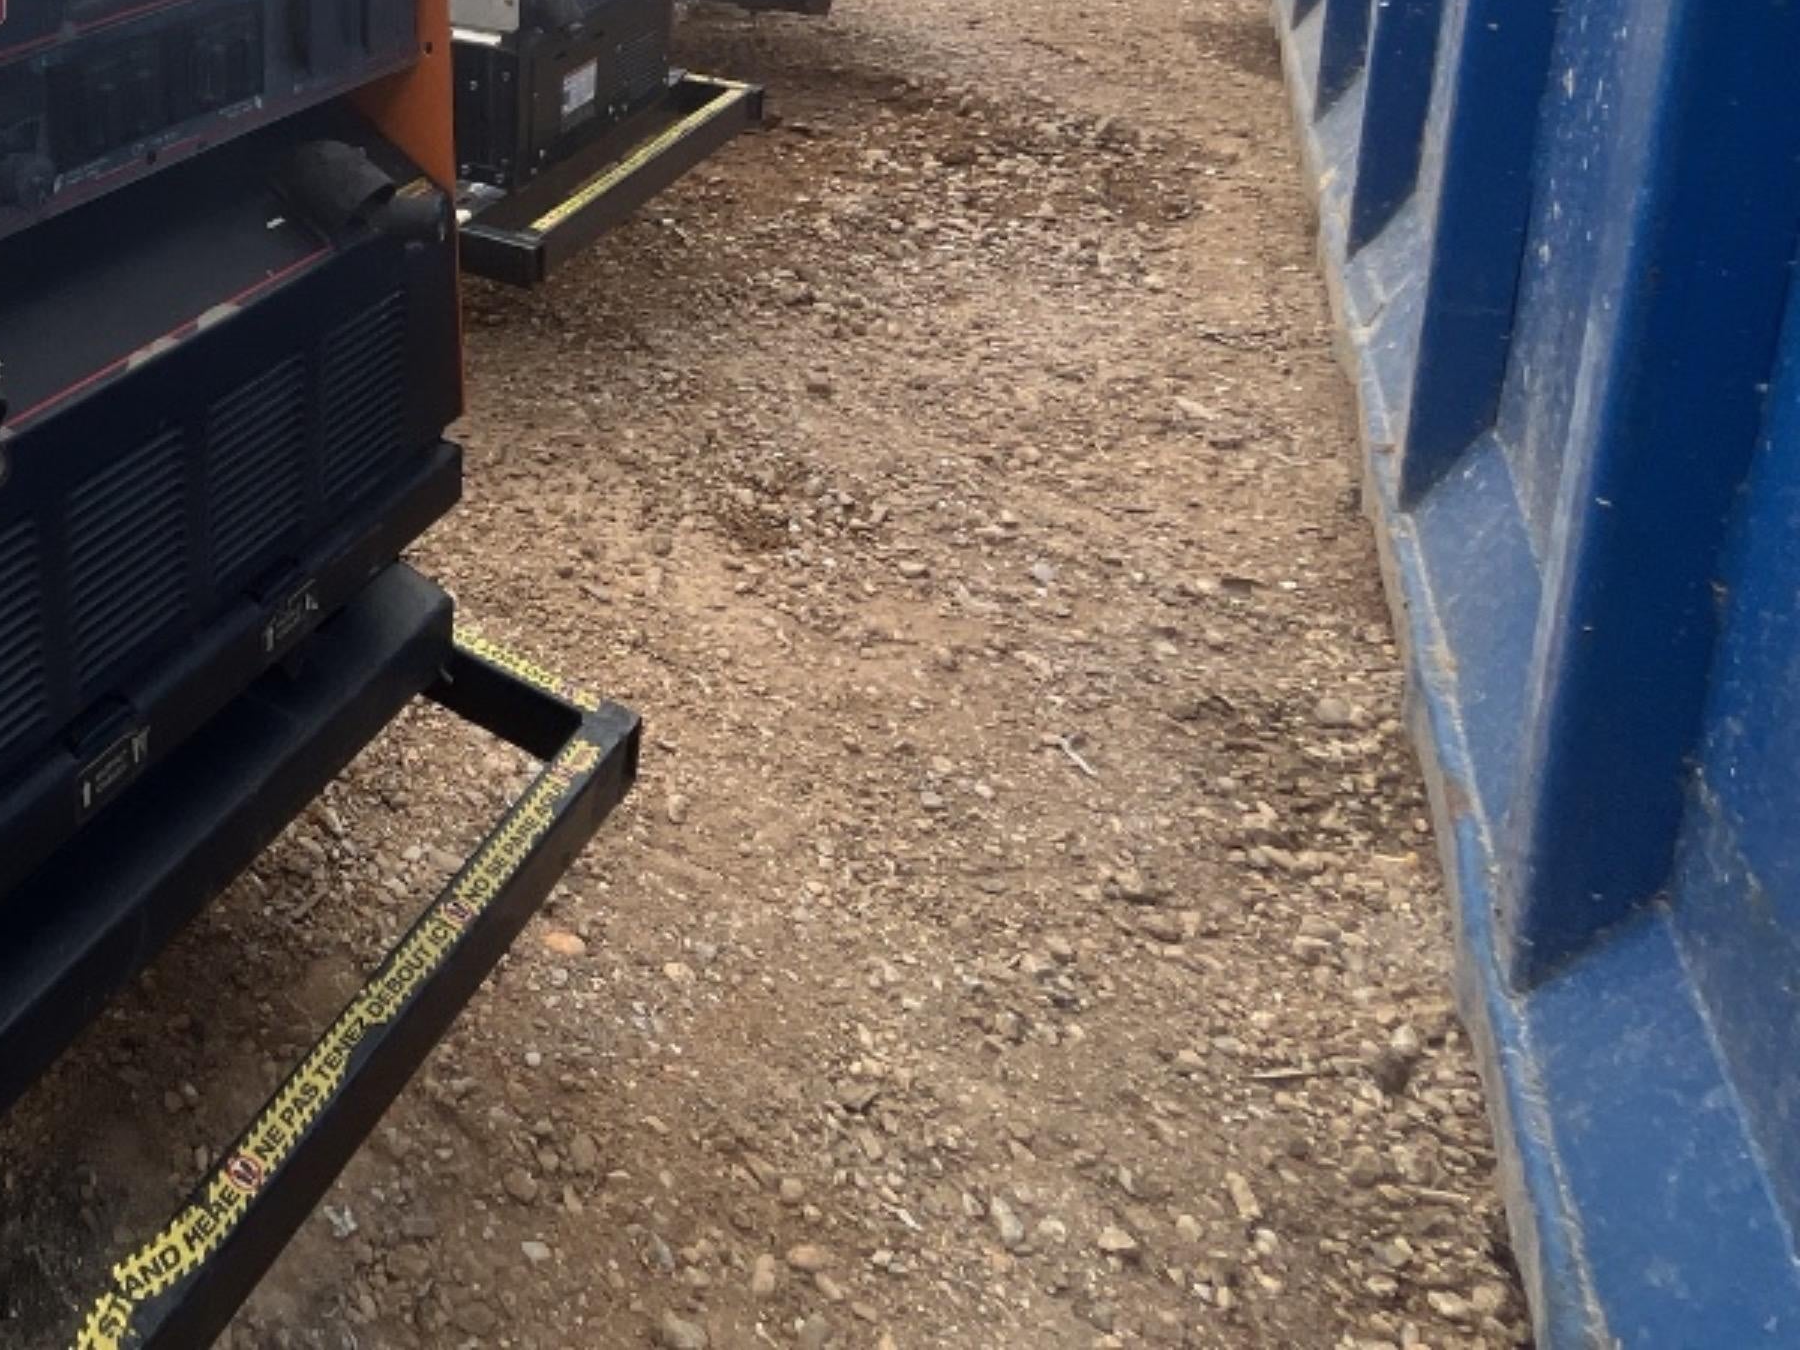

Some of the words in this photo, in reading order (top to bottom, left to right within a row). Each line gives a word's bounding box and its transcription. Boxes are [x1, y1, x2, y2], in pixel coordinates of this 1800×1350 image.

[182, 1184, 241, 1252] HERE
[254, 1124, 286, 1162] NE
[279, 1081, 320, 1128] PAS
[312, 1016, 367, 1081] TENEZ
[365, 943, 433, 1019] DEBOUT
[464, 876, 490, 901] NO
